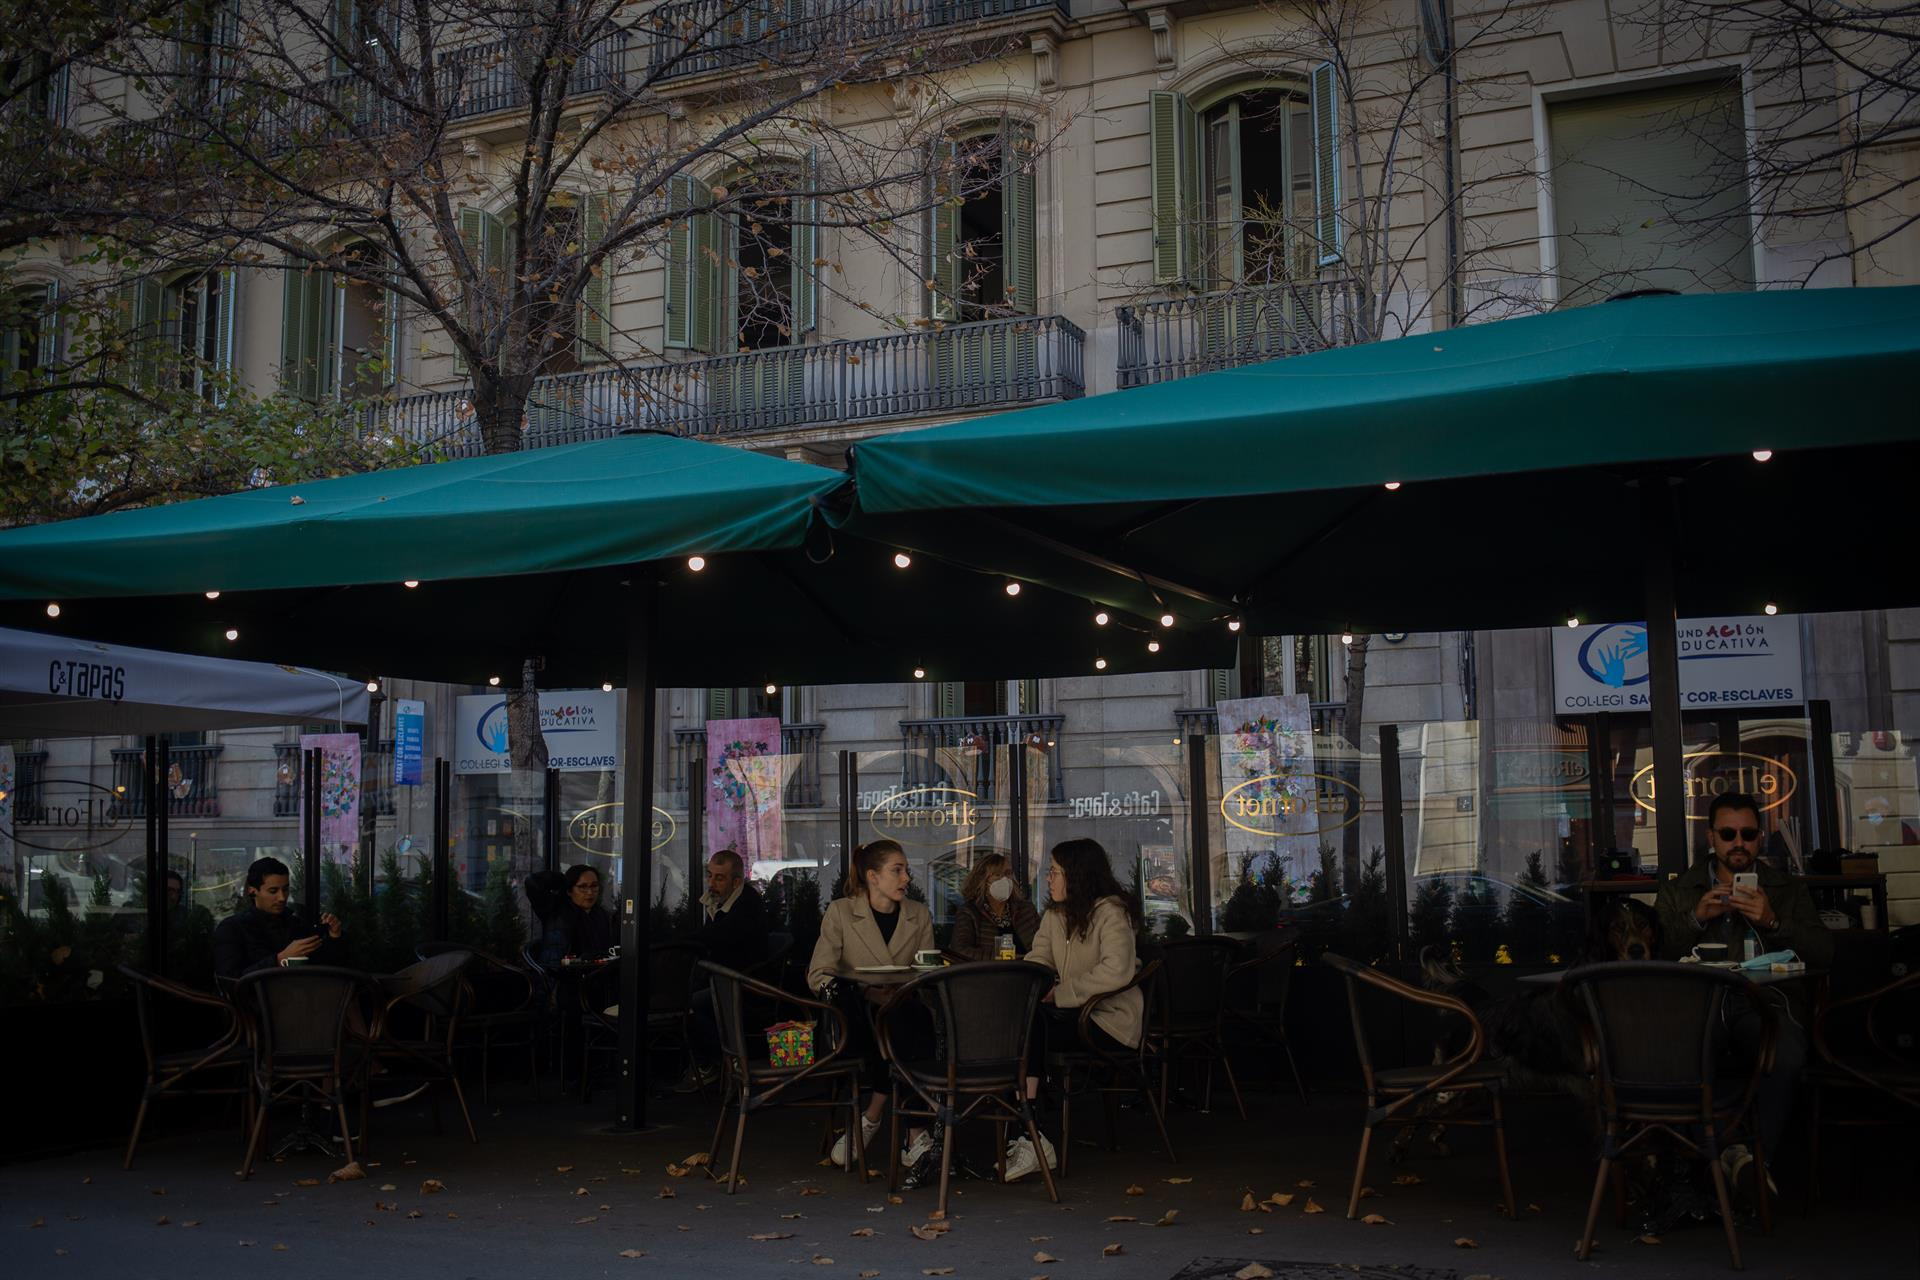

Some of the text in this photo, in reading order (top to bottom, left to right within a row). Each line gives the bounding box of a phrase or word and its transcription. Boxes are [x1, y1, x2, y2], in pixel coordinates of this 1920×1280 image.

[1677, 624, 1764, 638] UNDACIÓN
[1681, 638, 1769, 651] DUCATIVA
[1687, 688, 1794, 703] COR-ESCLAVES
[540, 705, 594, 718] UNDACIÓN
[541, 717, 596, 728] DUCATIVA
[547, 756, 616, 768] OR-ESCLAVES
